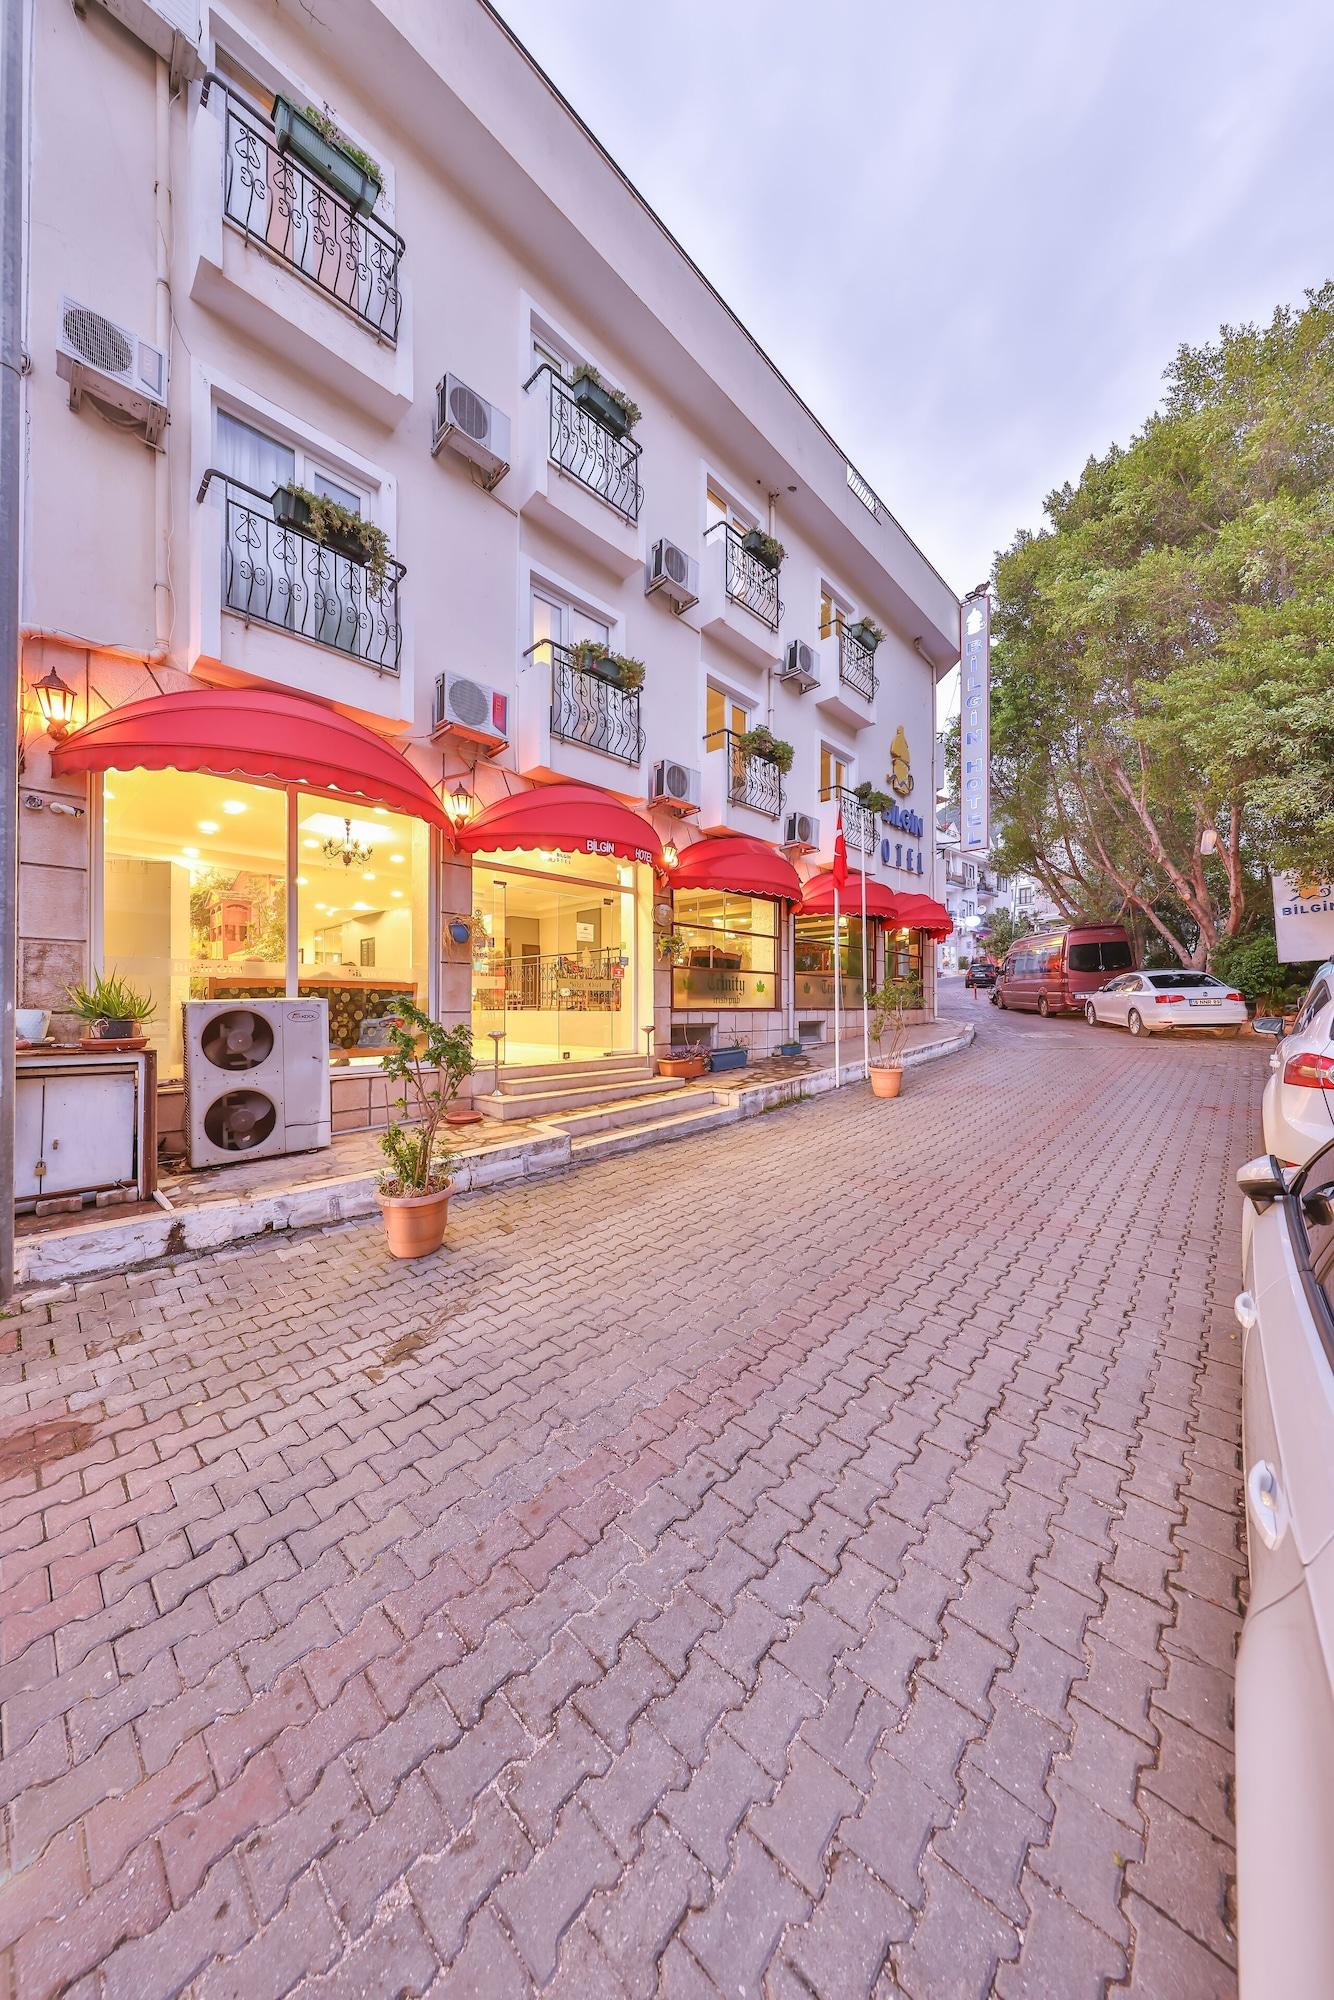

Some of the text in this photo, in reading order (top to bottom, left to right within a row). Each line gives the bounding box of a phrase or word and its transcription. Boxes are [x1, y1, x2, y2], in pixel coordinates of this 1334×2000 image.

[966, 757, 983, 845] HOTEL
[635, 847, 653, 864] HOTEL
[881, 838, 924, 875] OTEL
